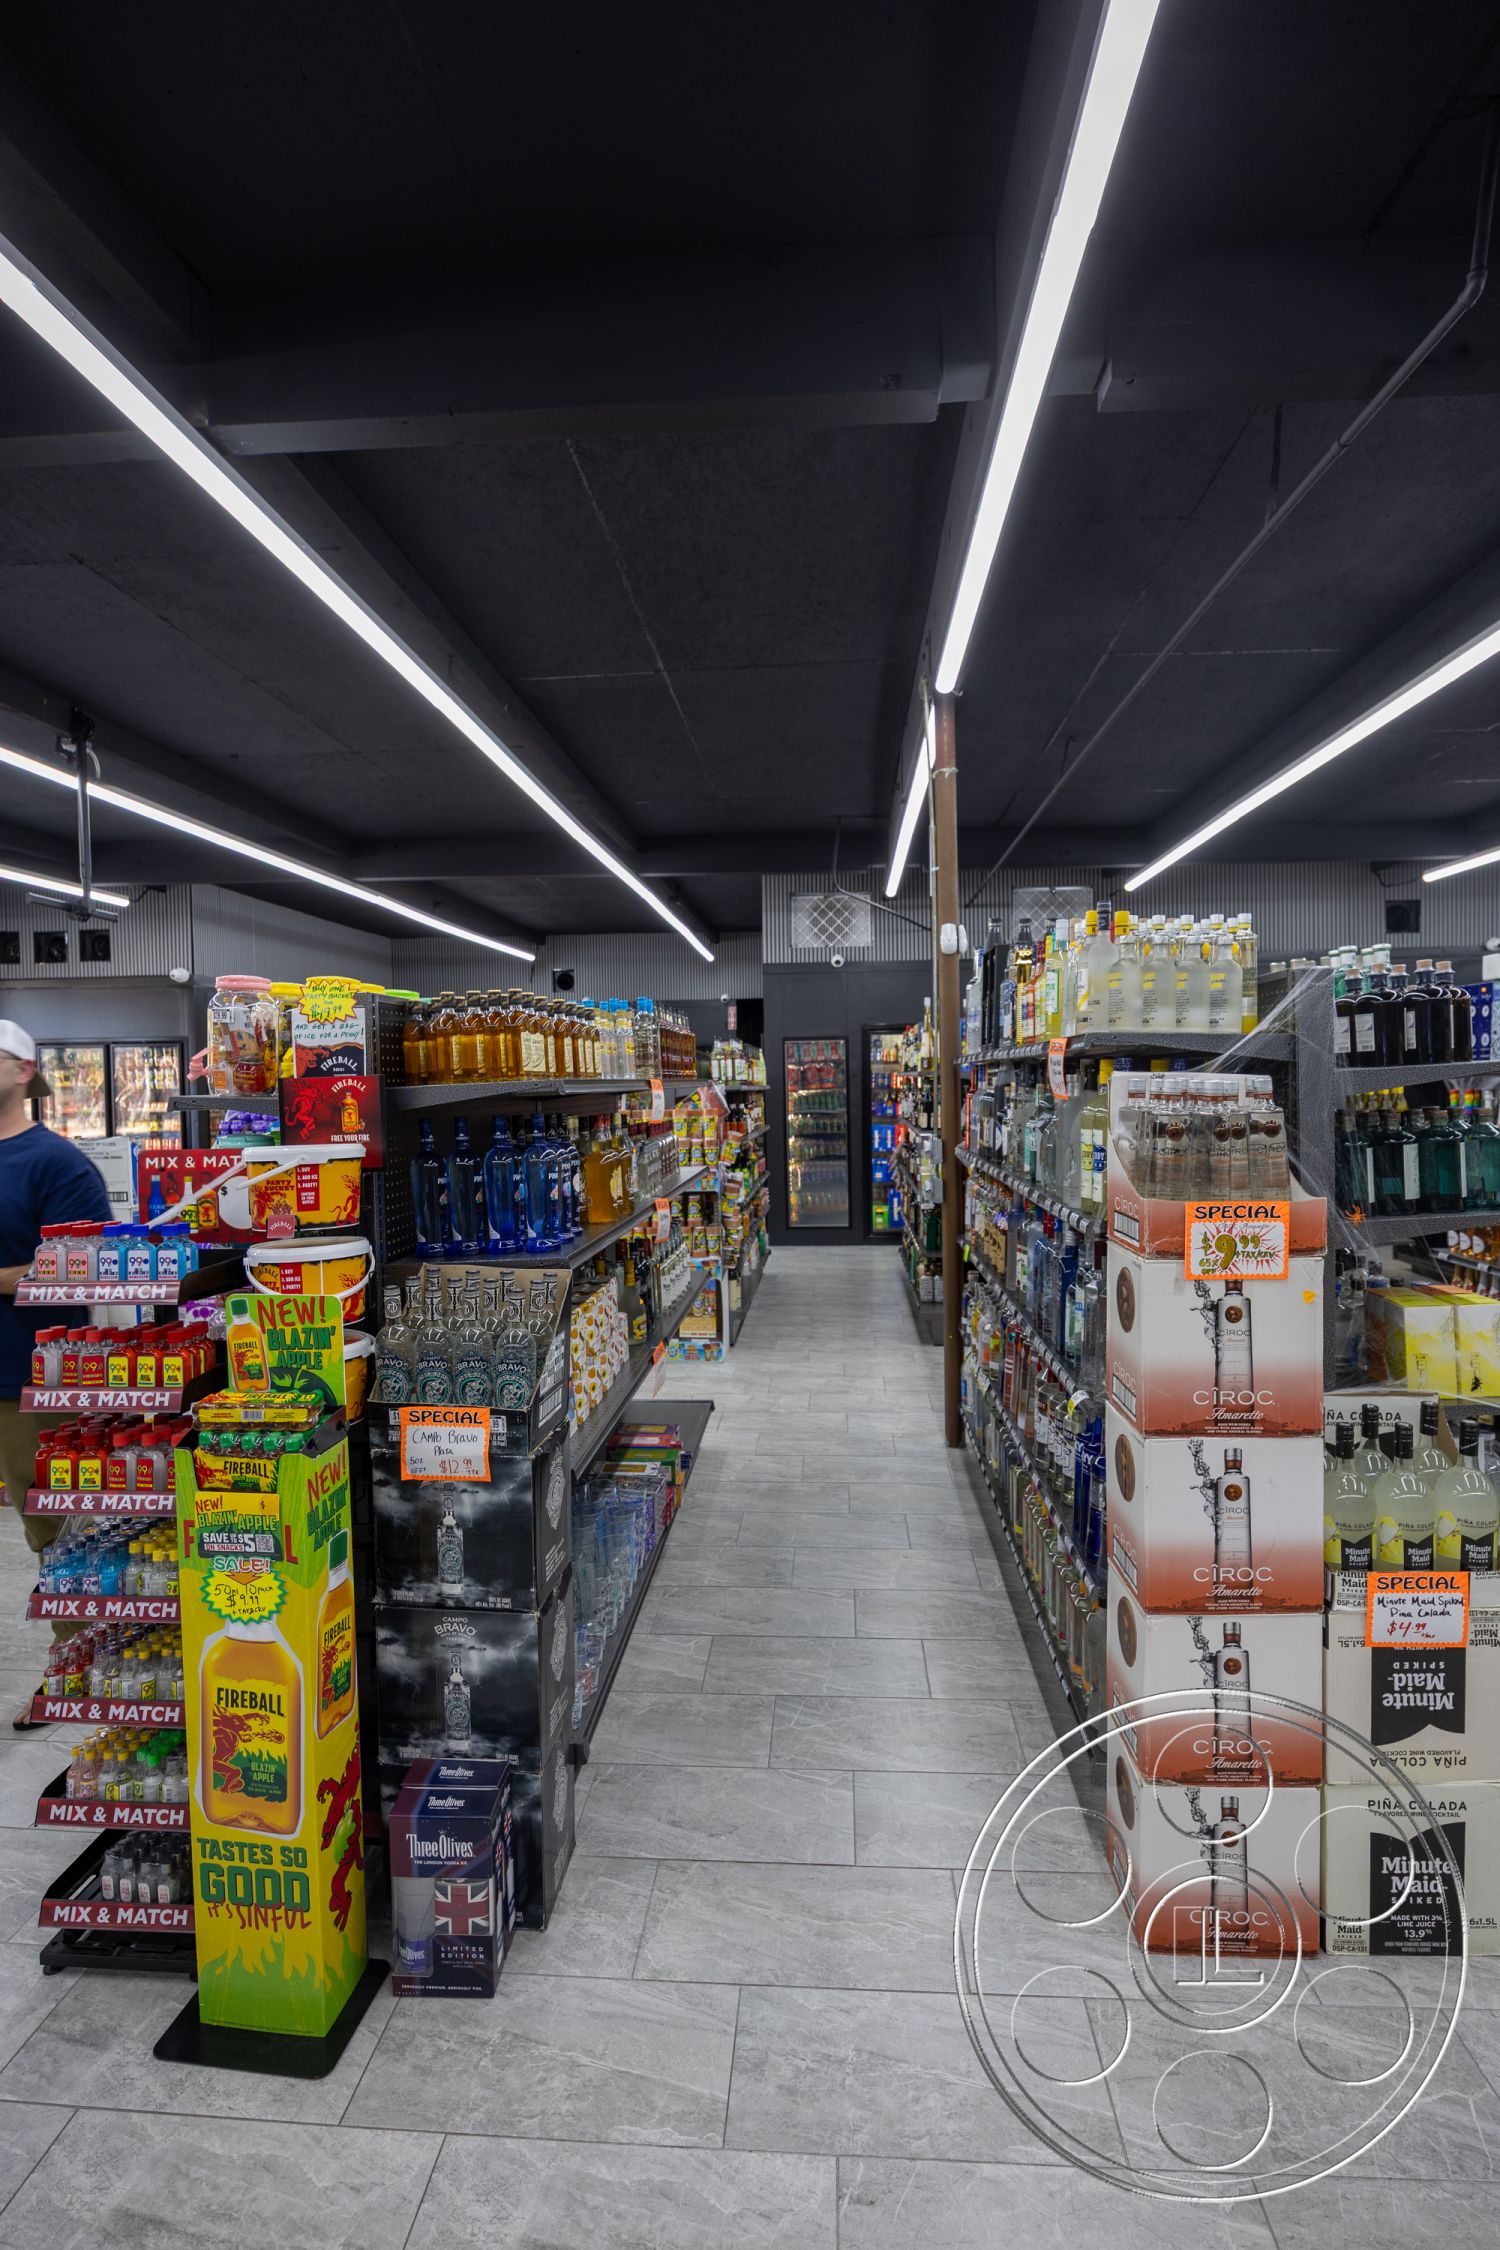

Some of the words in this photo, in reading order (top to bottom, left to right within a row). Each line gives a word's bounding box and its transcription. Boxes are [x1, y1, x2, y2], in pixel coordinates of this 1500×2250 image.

[313, 984, 327, 992] BUY
[339, 1022, 360, 1030] BAG
[320, 1056, 358, 1072] FIREBALL
[331, 1078, 367, 1093] FIREBALL
[331, 1134, 344, 1143] FREE
[344, 1134, 358, 1142] YOUR
[358, 1133, 370, 1142] FIRE
[145, 1156, 179, 1169] MIX
[184, 1156, 196, 1169] &
[220, 1186, 229, 1197] $
[1194, 1205, 1281, 1219] SPECIAL
[269, 1221, 293, 1231] FIREBALL
[29, 1286, 69, 1300] MIX
[74, 1286, 87, 1300] &
[94, 1285, 167, 1300] MATCH
[257, 1295, 325, 1333] NEW!
[267, 1325, 336, 1351] BLAZIN'
[233, 1341, 258, 1350] FIREBALL
[277, 1351, 322, 1370] APPLE
[418, 1361, 448, 1370] BRAVO
[457, 1361, 488, 1370] BRAVO
[497, 1363, 527, 1374] BRAVO
[33, 1392, 71, 1407] MIX
[77, 1392, 90, 1407] &
[98, 1391, 170, 1407] MATCH
[1192, 1387, 1274, 1406] CÎROC
[408, 1410, 483, 1424] SPECIAL
[1205, 1407, 1264, 1421] Amaretto
[223, 1460, 270, 1479] FIREBALL
[307, 1443, 346, 1513] NEW!
[37, 1495, 76, 1510] MIX
[81, 1495, 95, 1510] &
[101, 1495, 173, 1510] MATCH
[195, 1495, 223, 1514] NEW!
[260, 1500, 265, 1510] $
[197, 1510, 237, 1528] BLAZIN'
[237, 1514, 278, 1531] APPLE
[1336, 1521, 1351, 1529] PIÑA
[203, 1532, 229, 1543] SAVE
[314, 1512, 342, 1553] APPLE
[1344, 1547, 1371, 1555] Minute
[1407, 1547, 1432, 1555] Minute
[1464, 1543, 1492, 1552] Minute
[1349, 1554, 1369, 1562] Maid
[1411, 1555, 1430, 1563] Maid
[1468, 1551, 1489, 1559] Maid
[213, 1555, 272, 1574] SALE!
[1192, 1564, 1273, 1582] CÎROC
[1376, 1576, 1461, 1590] SPECIAL
[1206, 1584, 1264, 1597] Amaretto
[1377, 1596, 1409, 1606] Minute
[1411, 1596, 1436, 1606] Maid
[41, 1600, 79, 1615] MIX
[85, 1601, 98, 1616] &
[105, 1602, 177, 1617] MATCH
[323, 1614, 351, 1648] FIREBALL
[434, 1623, 476, 1636] BRAVO
[1473, 1629, 1499, 1638] Maid
[1393, 1661, 1445, 1669] SPIKED
[1392, 1672, 1446, 1691] Maid
[216, 1687, 285, 1717] FIREBALL
[1382, 1692, 1455, 1711] Minute
[44, 1701, 83, 1719] MIX
[88, 1703, 102, 1720] &
[108, 1704, 180, 1722] MATCH
[1192, 1736, 1273, 1755] CÎROC
[251, 1761, 278, 1773] BLAZIN'
[1205, 1756, 1263, 1769] Amaretto
[1434, 1757, 1467, 1768] PIÑA
[253, 1773, 275, 1783] APPLE
[1367, 1798, 1402, 1810] PIÑA
[50, 1804, 88, 1822] MIX
[93, 1805, 107, 1822] &
[113, 1807, 185, 1825] MATCH
[196, 1837, 274, 1865] TASTES
[280, 1845, 307, 1869] SO
[405, 1833, 438, 1859] Three
[439, 1834, 473, 1859] Olives
[1381, 1856, 1452, 1874] Minute
[199, 1862, 311, 1913] GOOD
[1389, 1875, 1444, 1893] Maid
[53, 1905, 92, 1922] MIX
[97, 1906, 111, 1924] &
[116, 1908, 188, 1925] MATCH
[236, 1899, 312, 1933] SINFUL
[1469, 1918, 1498, 1926] 6x1.5L
[1337, 1925, 1365, 1934] Maid
[1404, 1928, 1433, 1938] 13.9%
